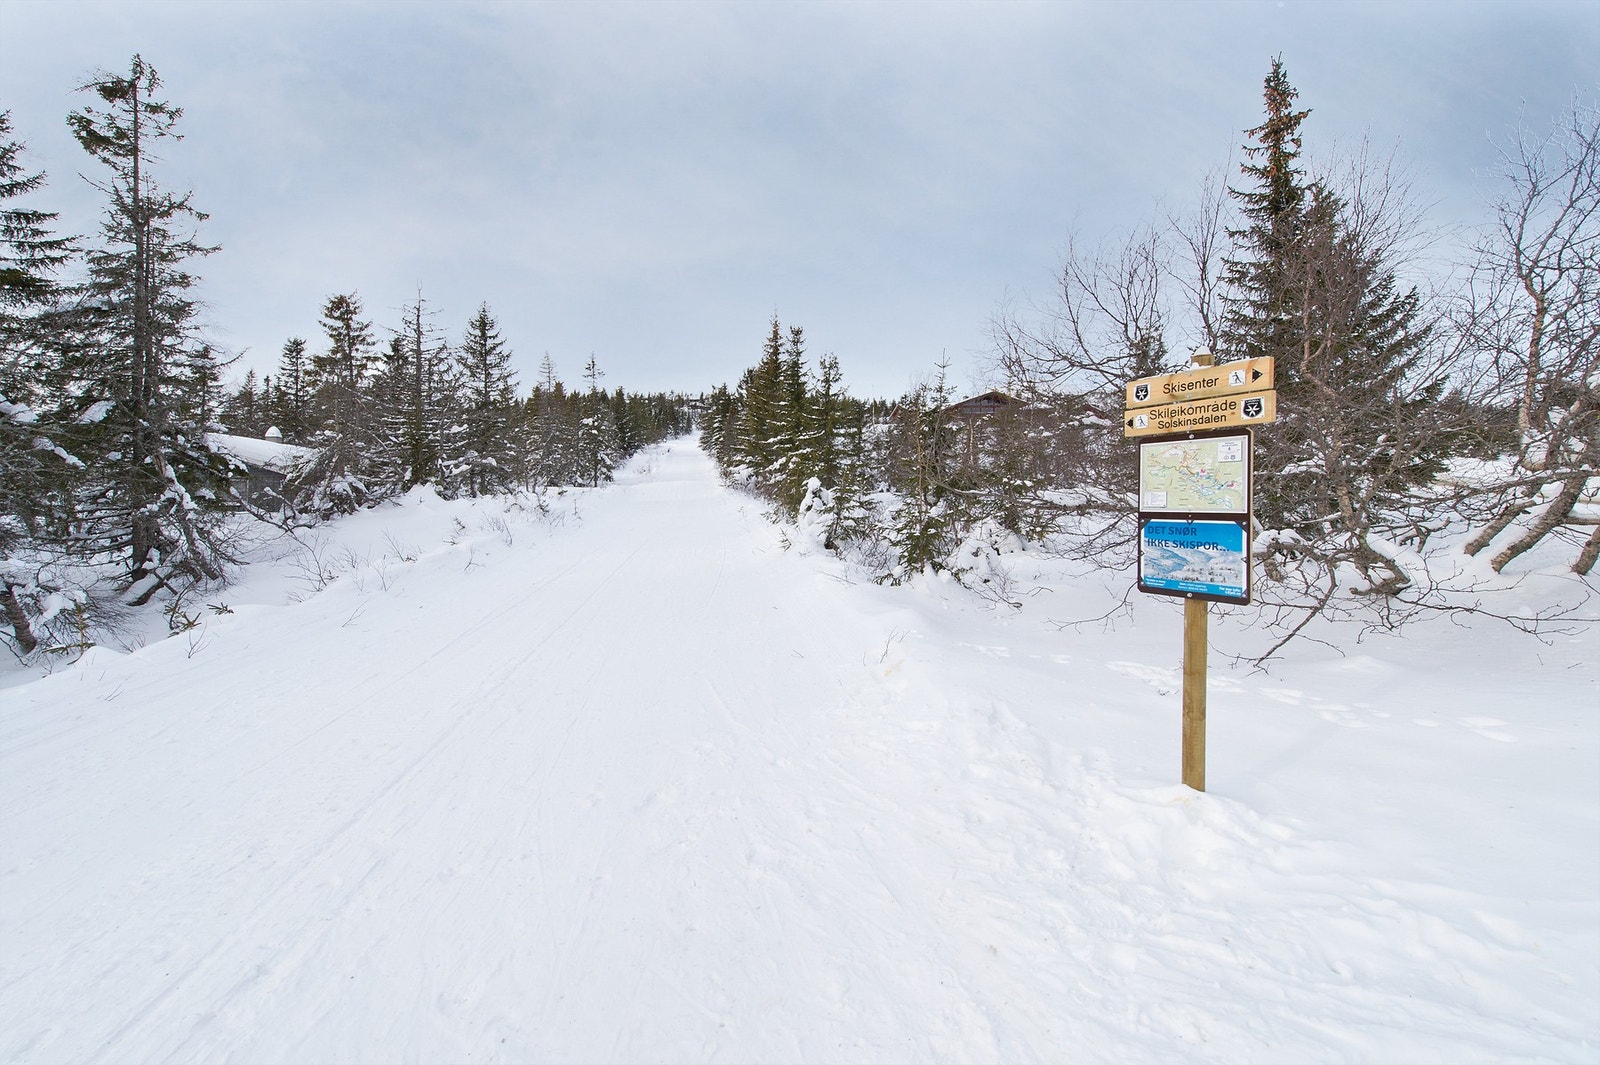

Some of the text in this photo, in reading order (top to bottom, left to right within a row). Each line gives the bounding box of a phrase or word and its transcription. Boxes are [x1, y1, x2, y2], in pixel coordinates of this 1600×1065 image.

[1163, 377, 1219, 394] Skisenter
[1149, 400, 1237, 420] Skileikområde
[1157, 414, 1227, 429] Solskinsdalen
[1148, 526, 1197, 536] DET SNØR
[1147, 539, 1230, 552] IKKE SKISPOR...
